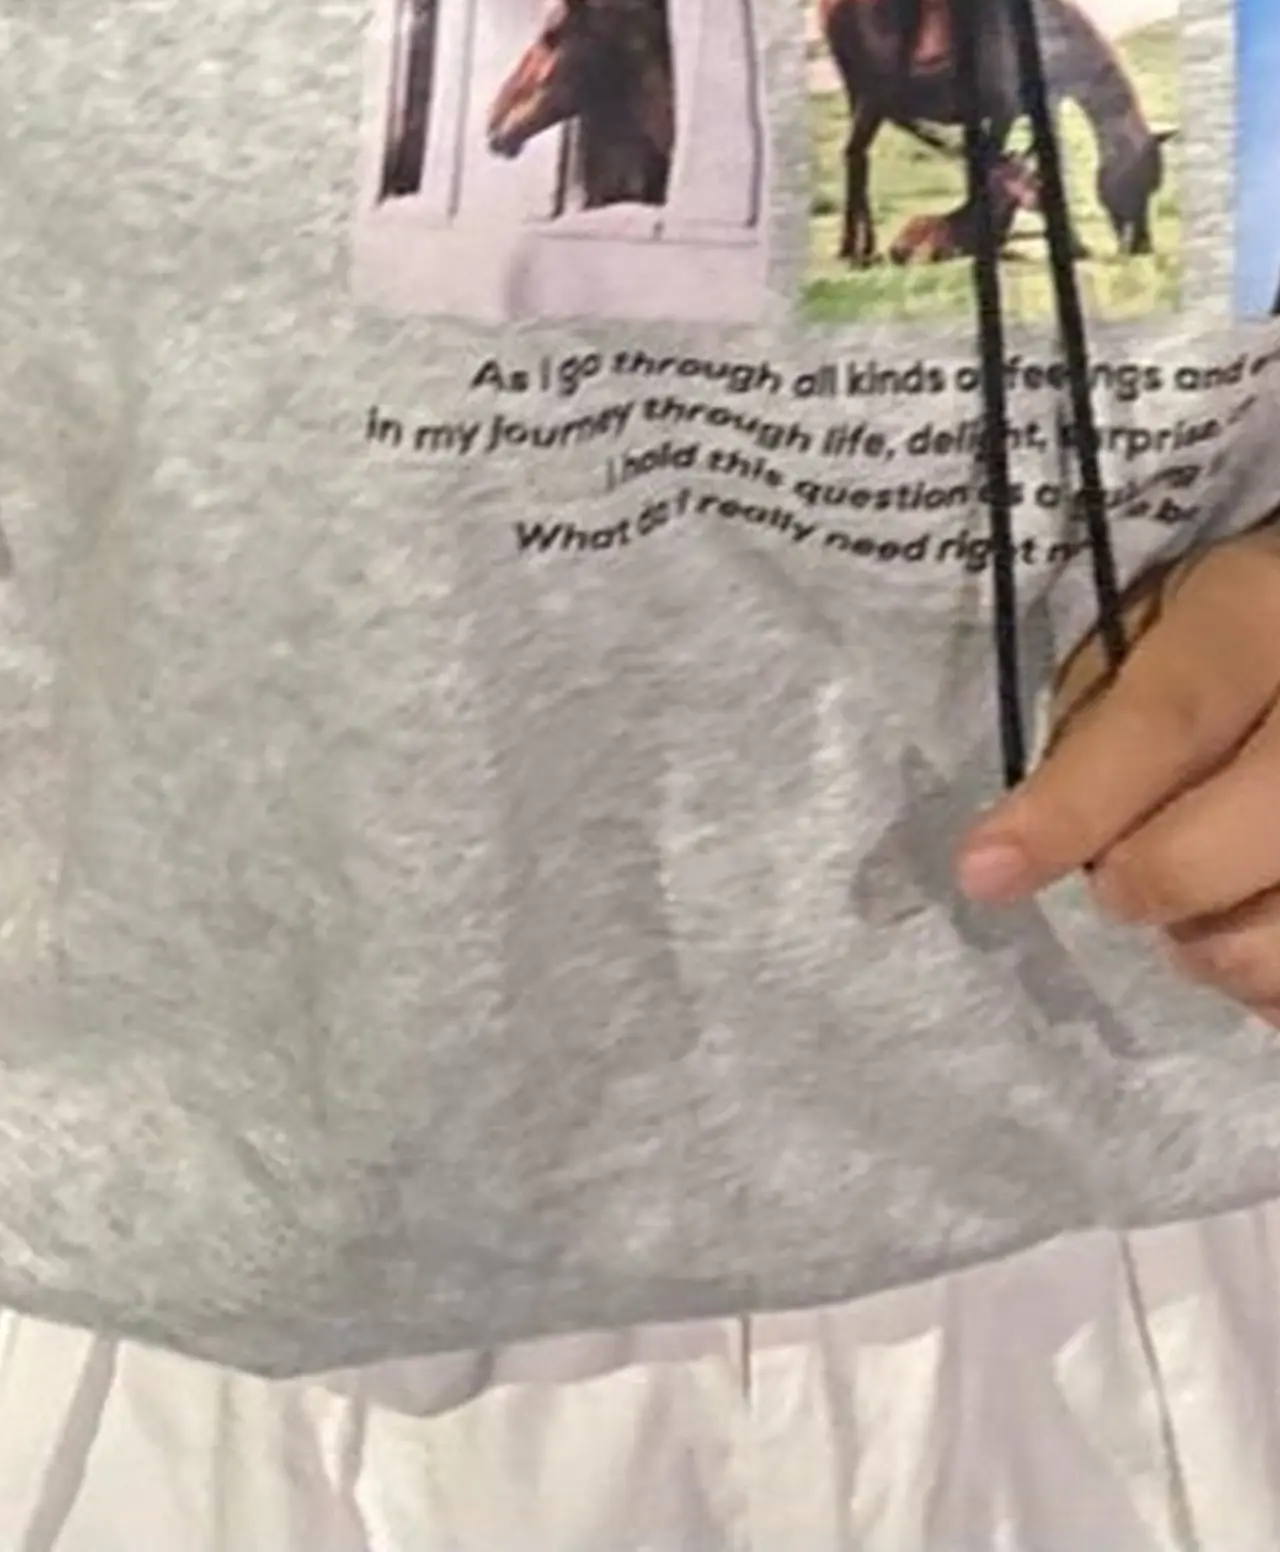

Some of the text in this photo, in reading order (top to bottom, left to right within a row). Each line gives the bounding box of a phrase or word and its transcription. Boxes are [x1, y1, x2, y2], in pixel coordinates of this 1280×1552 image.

[471, 360, 529, 392] As
[557, 353, 602, 396] go
[613, 350, 784, 394] through
[793, 363, 838, 397] all
[845, 359, 947, 397] kinds
[1004, 355, 1163, 401] feengs
[1174, 352, 1248, 391] and
[366, 405, 403, 446] in
[413, 422, 481, 455] my
[484, 400, 635, 454] journey
[642, 396, 813, 453] through
[821, 421, 898, 461] life,
[621, 441, 700, 483] hold
[708, 448, 786, 487] this
[793, 480, 970, 513] question
[1034, 483, 1061, 509] a
[515, 519, 631, 554] What
[694, 492, 818, 543] really
[823, 530, 932, 563] need
[937, 529, 1037, 575] rigt
